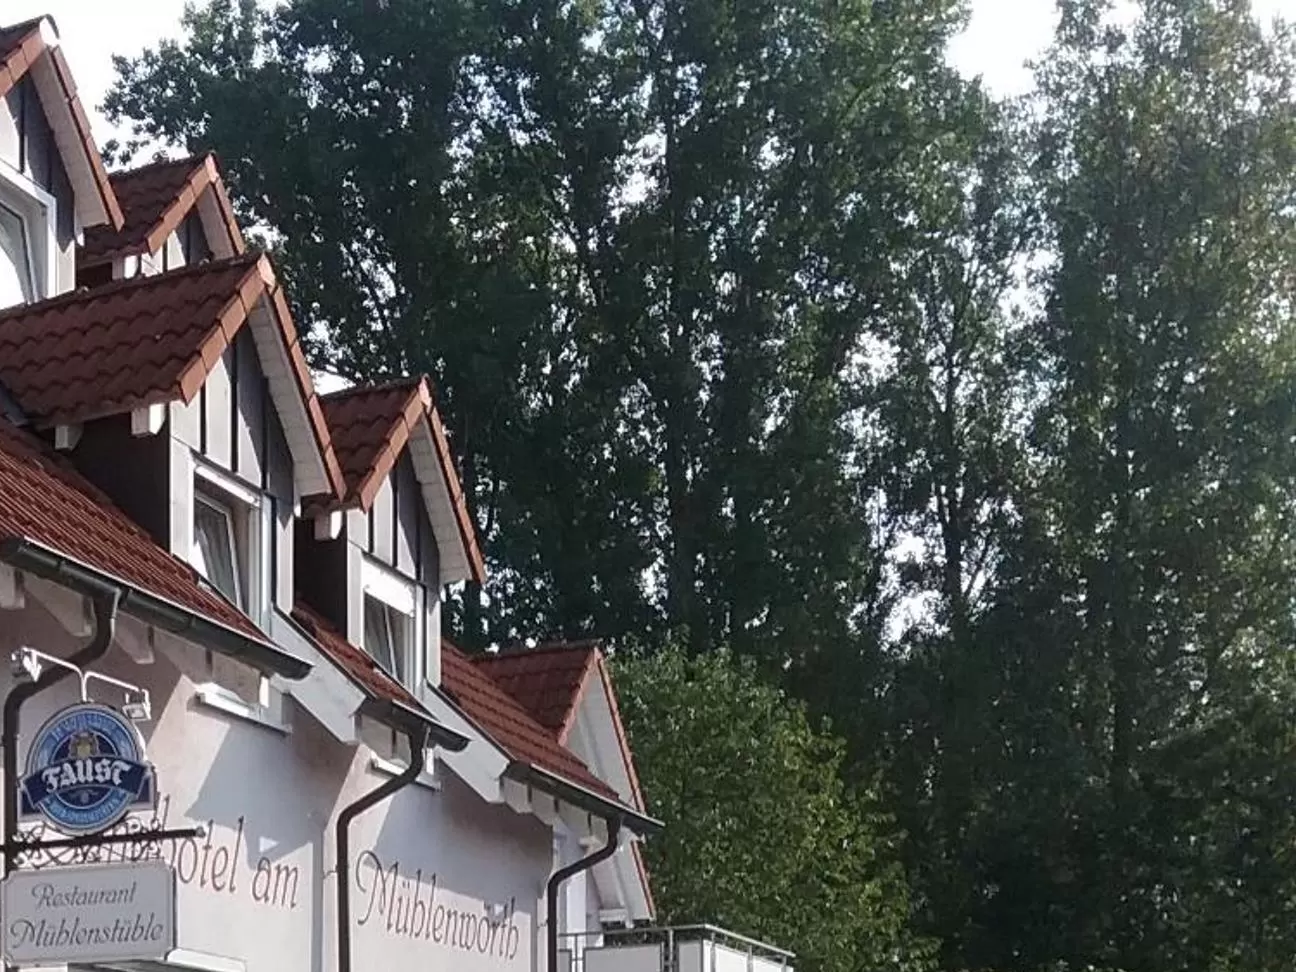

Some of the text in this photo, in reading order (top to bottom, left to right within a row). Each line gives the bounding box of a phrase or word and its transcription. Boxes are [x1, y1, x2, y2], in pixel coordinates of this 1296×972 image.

[42, 757, 132, 794] FAUST
[31, 882, 137, 909] Restaurant
[251, 856, 302, 910] am
[355, 850, 520, 960] Mühlenwörth
[10, 914, 164, 949] Mühlenstüble
